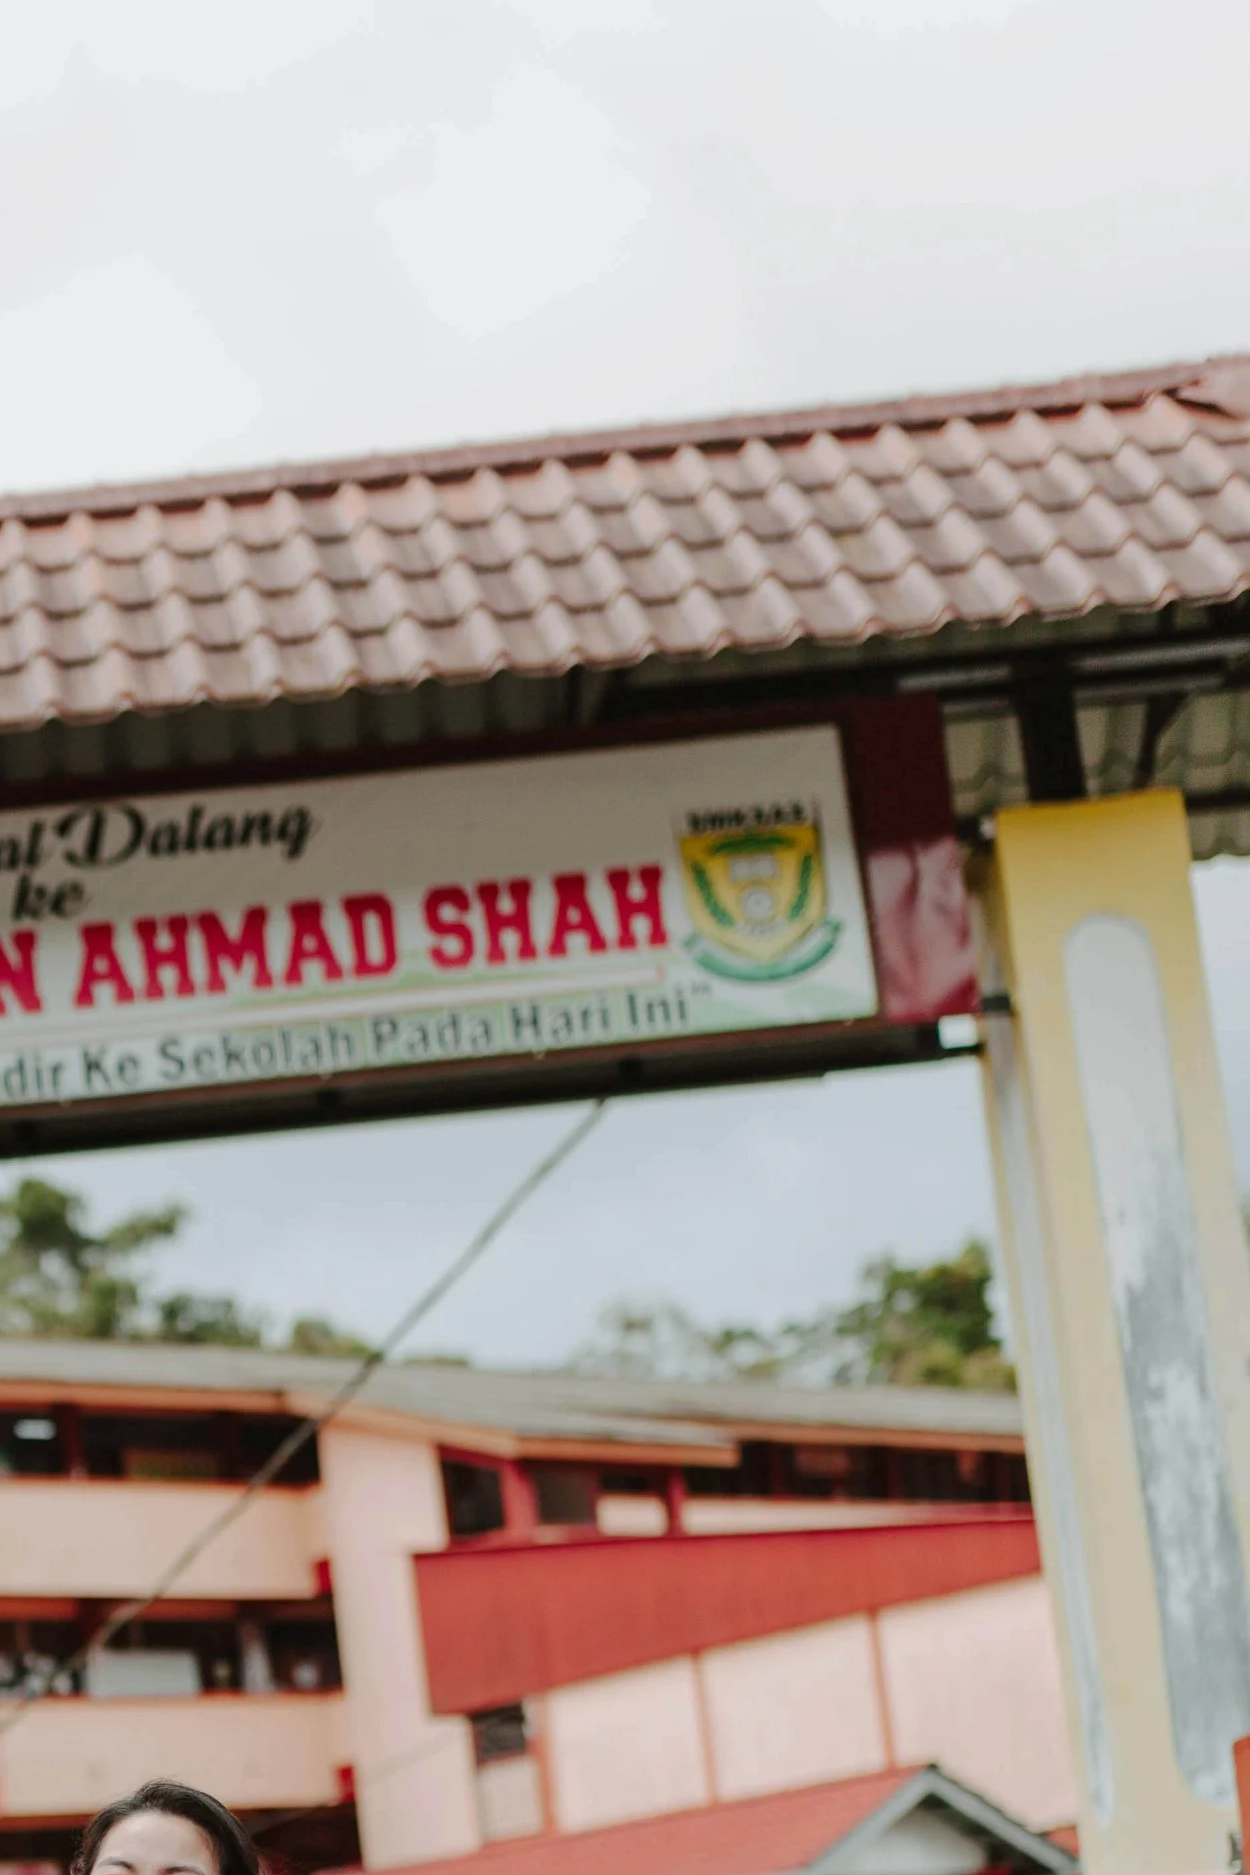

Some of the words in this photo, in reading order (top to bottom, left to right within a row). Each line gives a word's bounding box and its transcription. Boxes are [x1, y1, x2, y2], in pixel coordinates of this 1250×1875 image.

[11, 872, 86, 922] ke
[75, 894, 398, 1007] AHMAD
[423, 866, 668, 968] SHAH
[82, 1046, 140, 1092] Ke
[158, 1022, 356, 1082] Sekolah
[371, 1011, 493, 1060] Pada
[510, 991, 611, 1043] Hari
